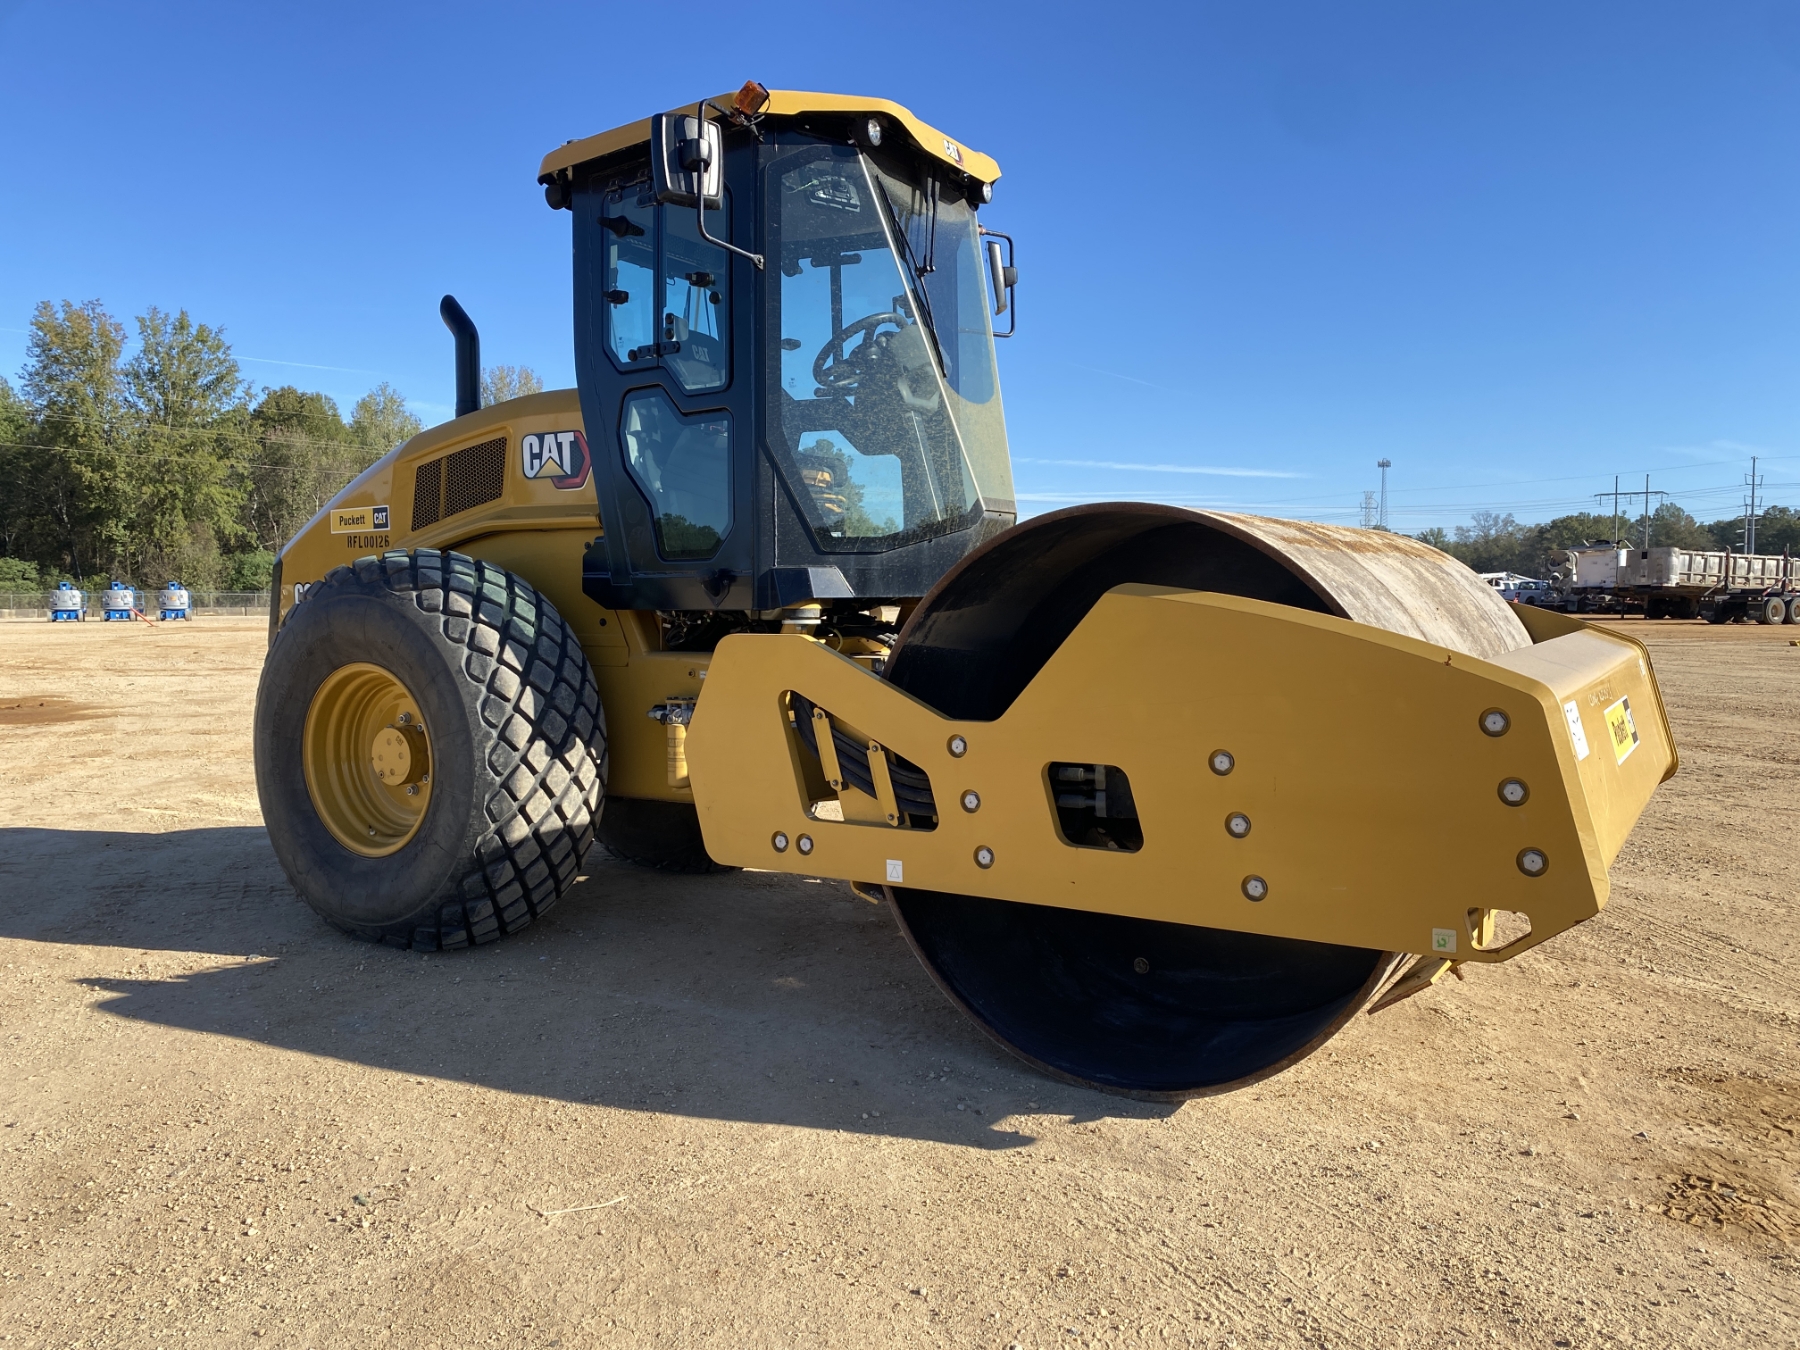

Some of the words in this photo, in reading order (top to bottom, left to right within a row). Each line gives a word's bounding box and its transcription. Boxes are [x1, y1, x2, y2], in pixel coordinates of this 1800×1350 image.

[943, 139, 960, 161] CAT
[691, 344, 710, 362] CAT
[522, 431, 575, 479] CAT
[339, 515, 366, 526] Puckett
[373, 512, 387, 524] CAT
[347, 535, 390, 548] RFL00126
